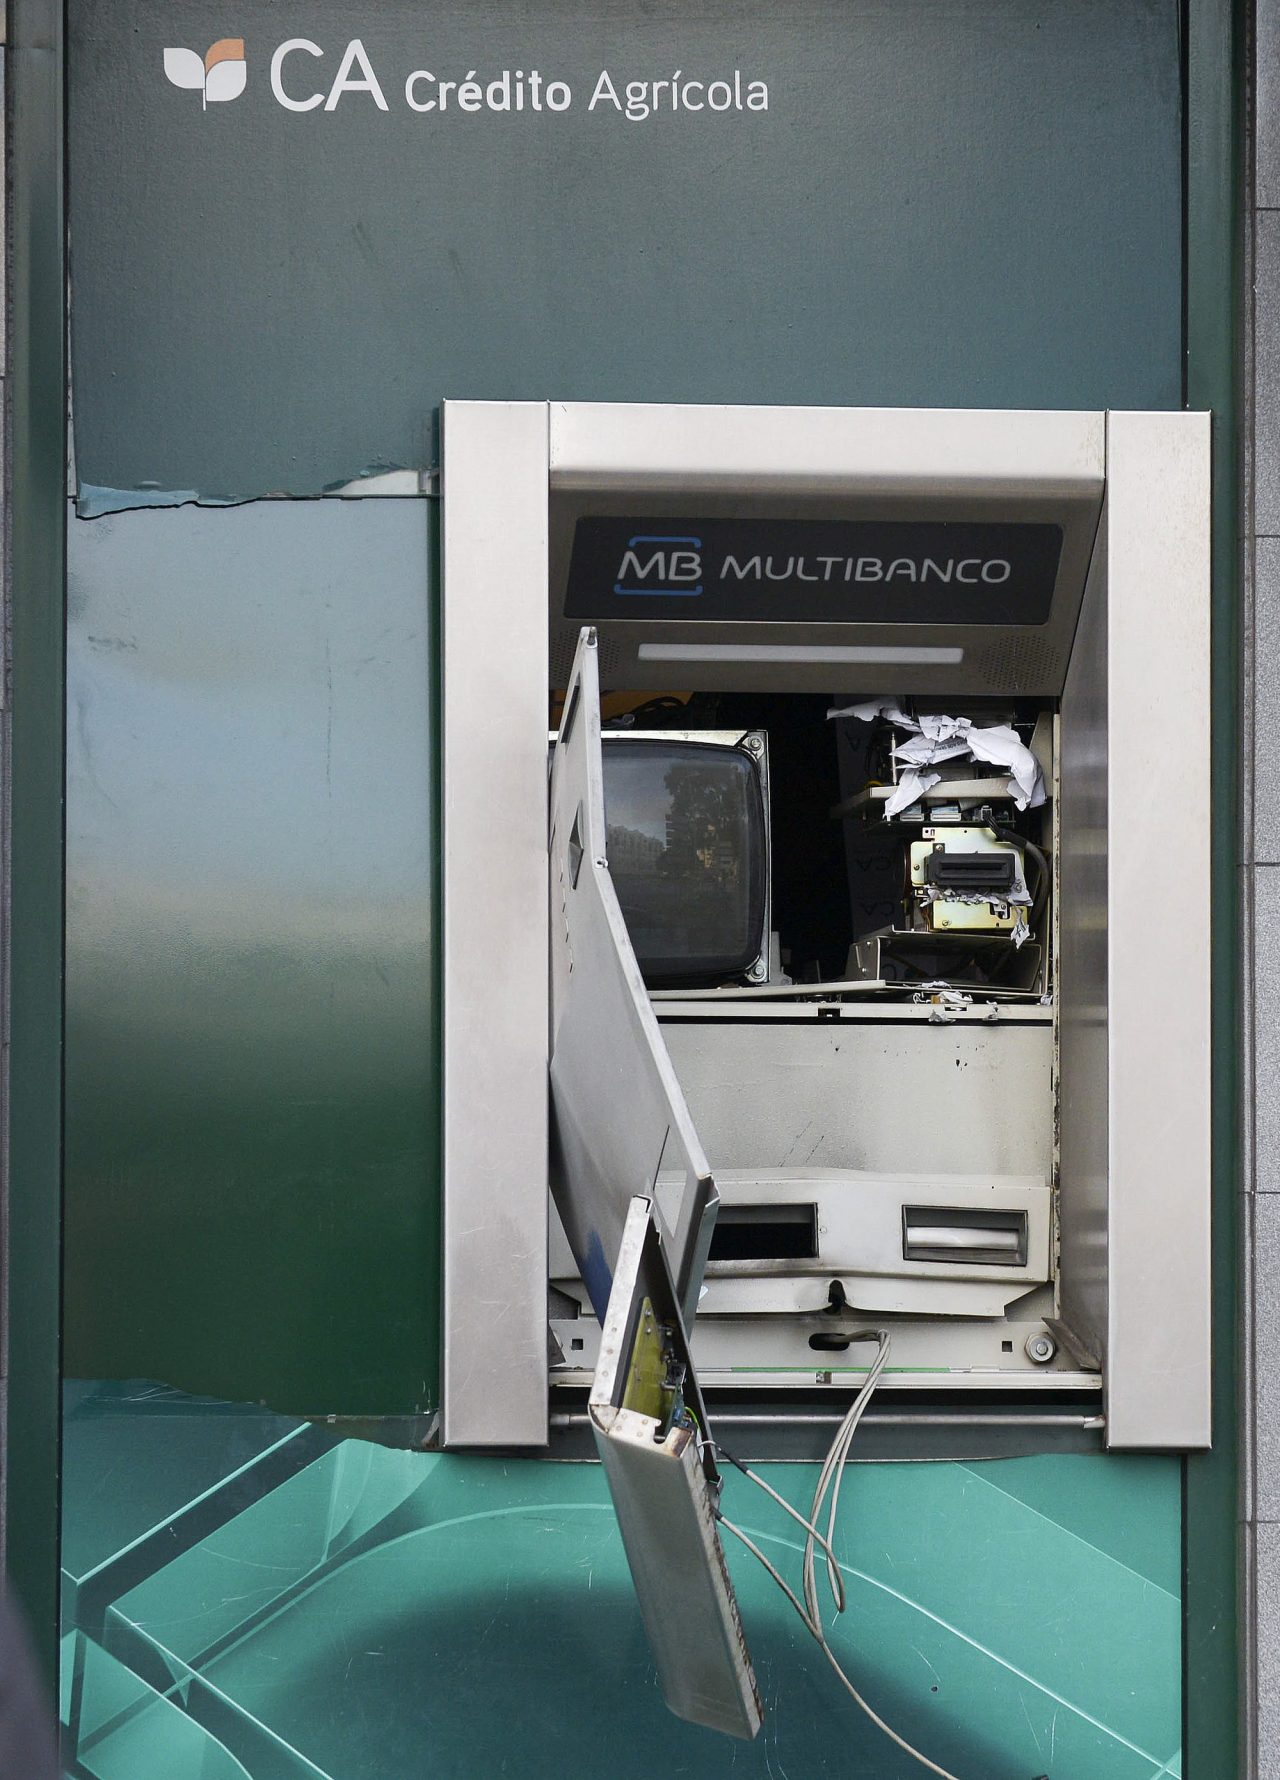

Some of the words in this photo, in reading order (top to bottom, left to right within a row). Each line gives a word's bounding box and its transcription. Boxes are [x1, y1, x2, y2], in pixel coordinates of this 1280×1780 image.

[270, 38, 390, 112] CA
[404, 69, 573, 112] Crédito
[588, 70, 769, 121] Agrícola
[617, 551, 702, 581] MB
[719, 555, 1011, 583] MULTIBANCO
